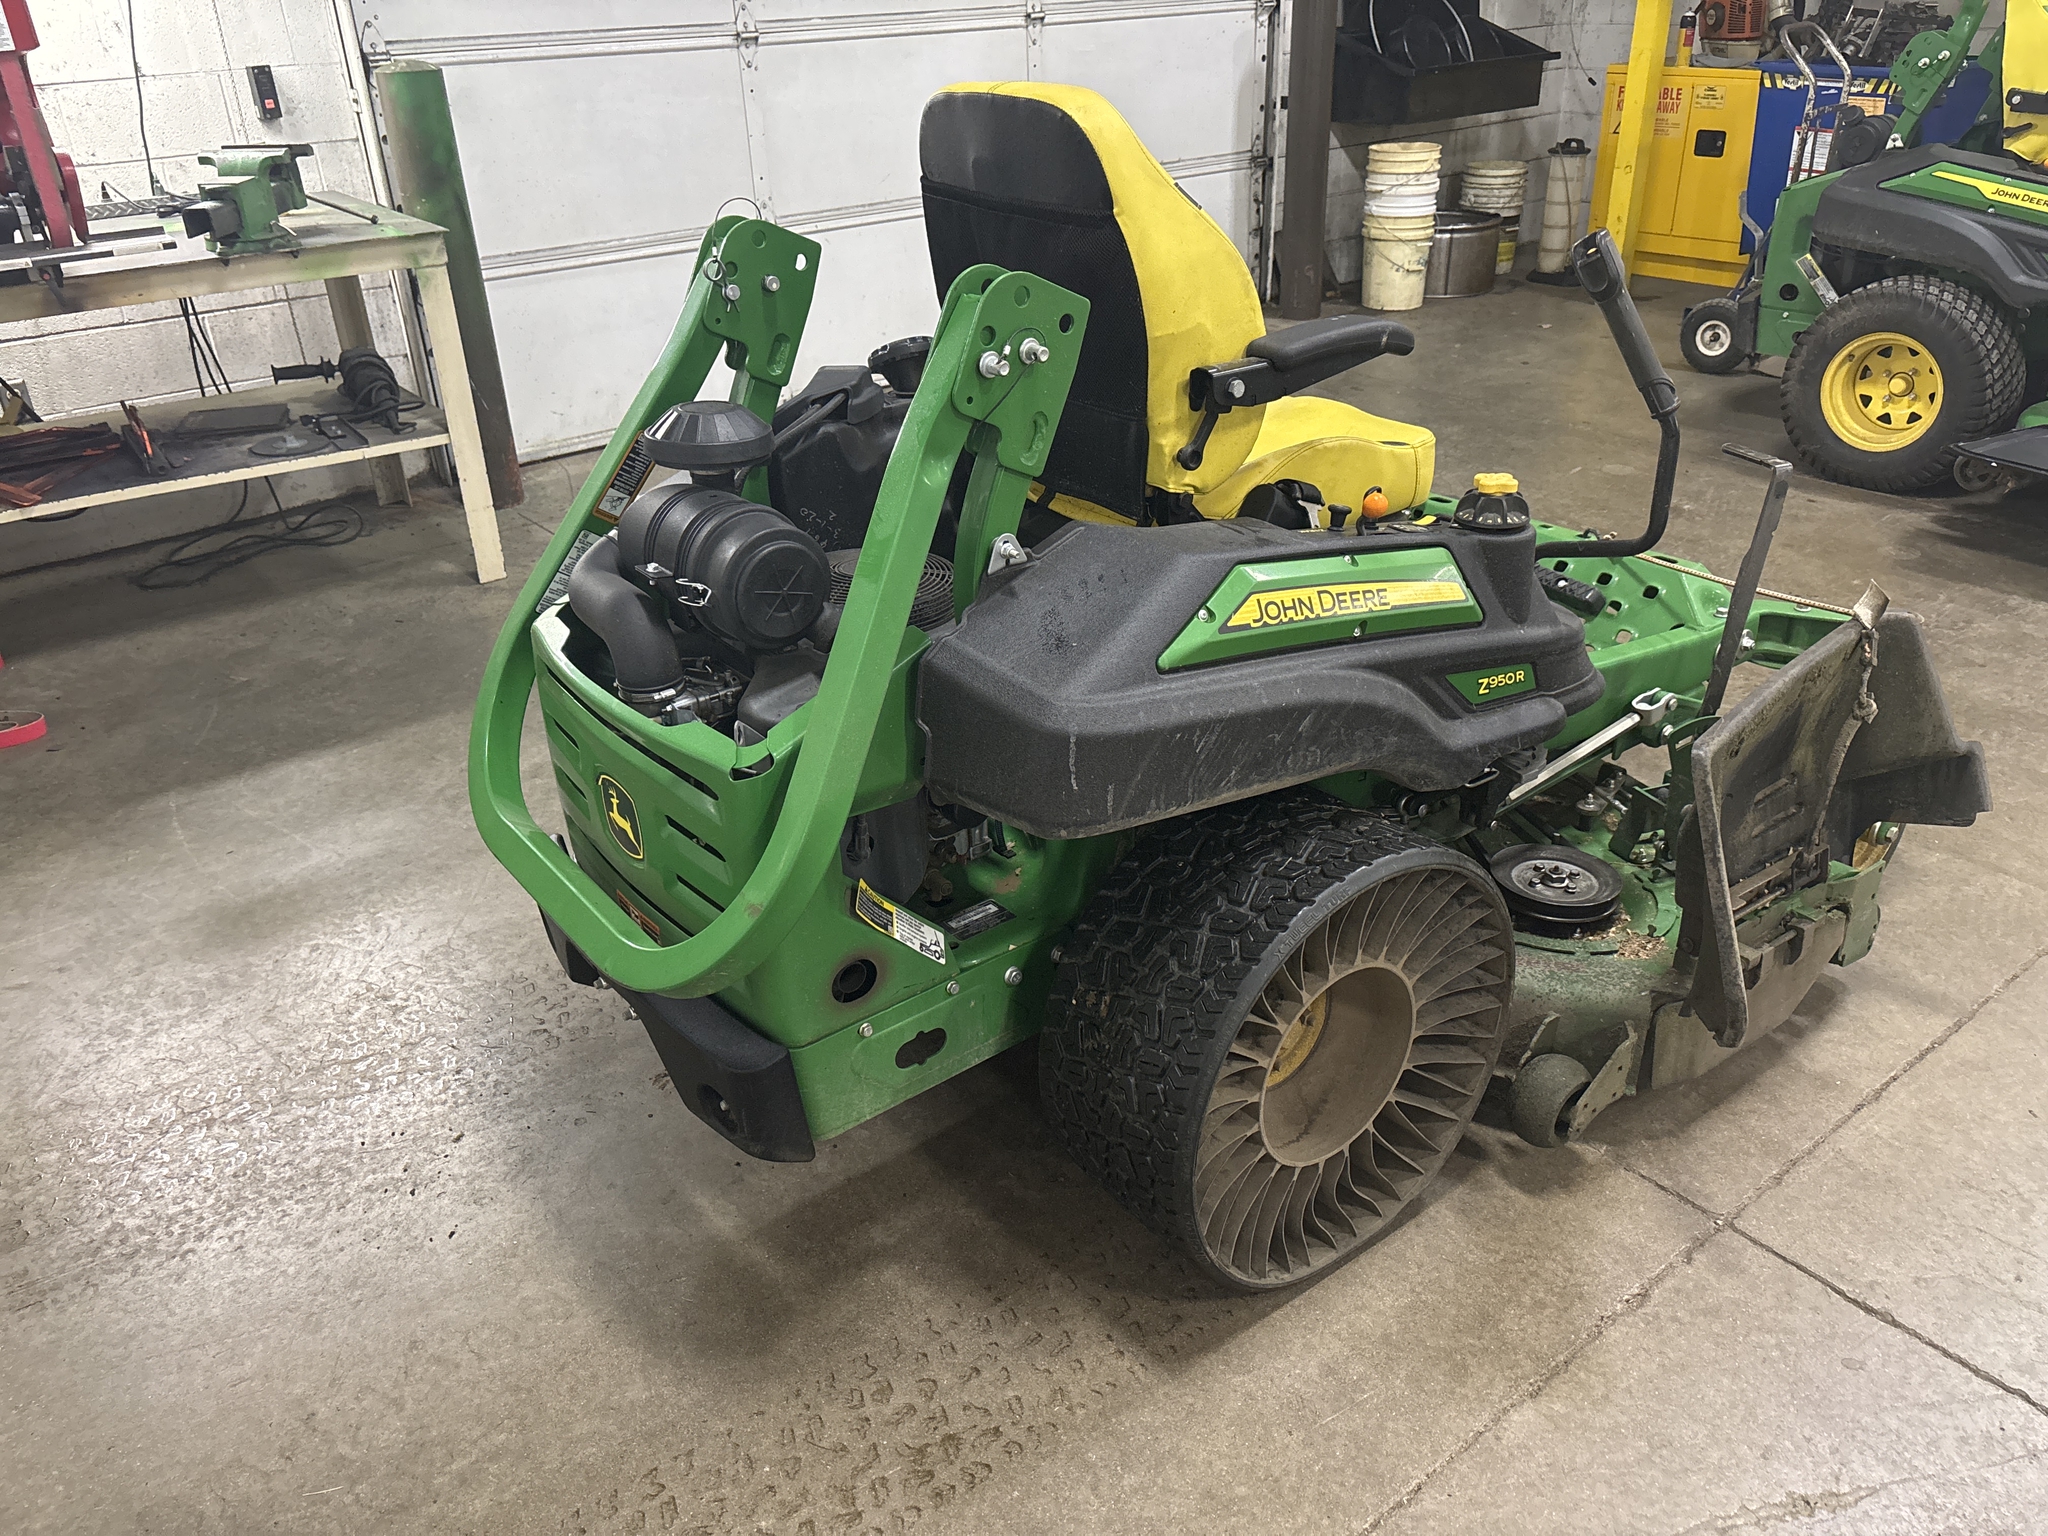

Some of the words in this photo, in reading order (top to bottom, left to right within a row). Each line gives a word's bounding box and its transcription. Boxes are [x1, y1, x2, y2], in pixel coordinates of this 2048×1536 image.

[1656, 100, 1681, 114] AWAY
[1991, 187, 2021, 200] JOHN
[1252, 596, 1316, 624] JOHN
[1316, 587, 1391, 613] DEERE
[1477, 669, 1526, 695] Z950R
[1273, 948, 1285, 959] X
[1284, 911, 1323, 948] TWEEL
[1321, 887, 1351, 910] TURF
